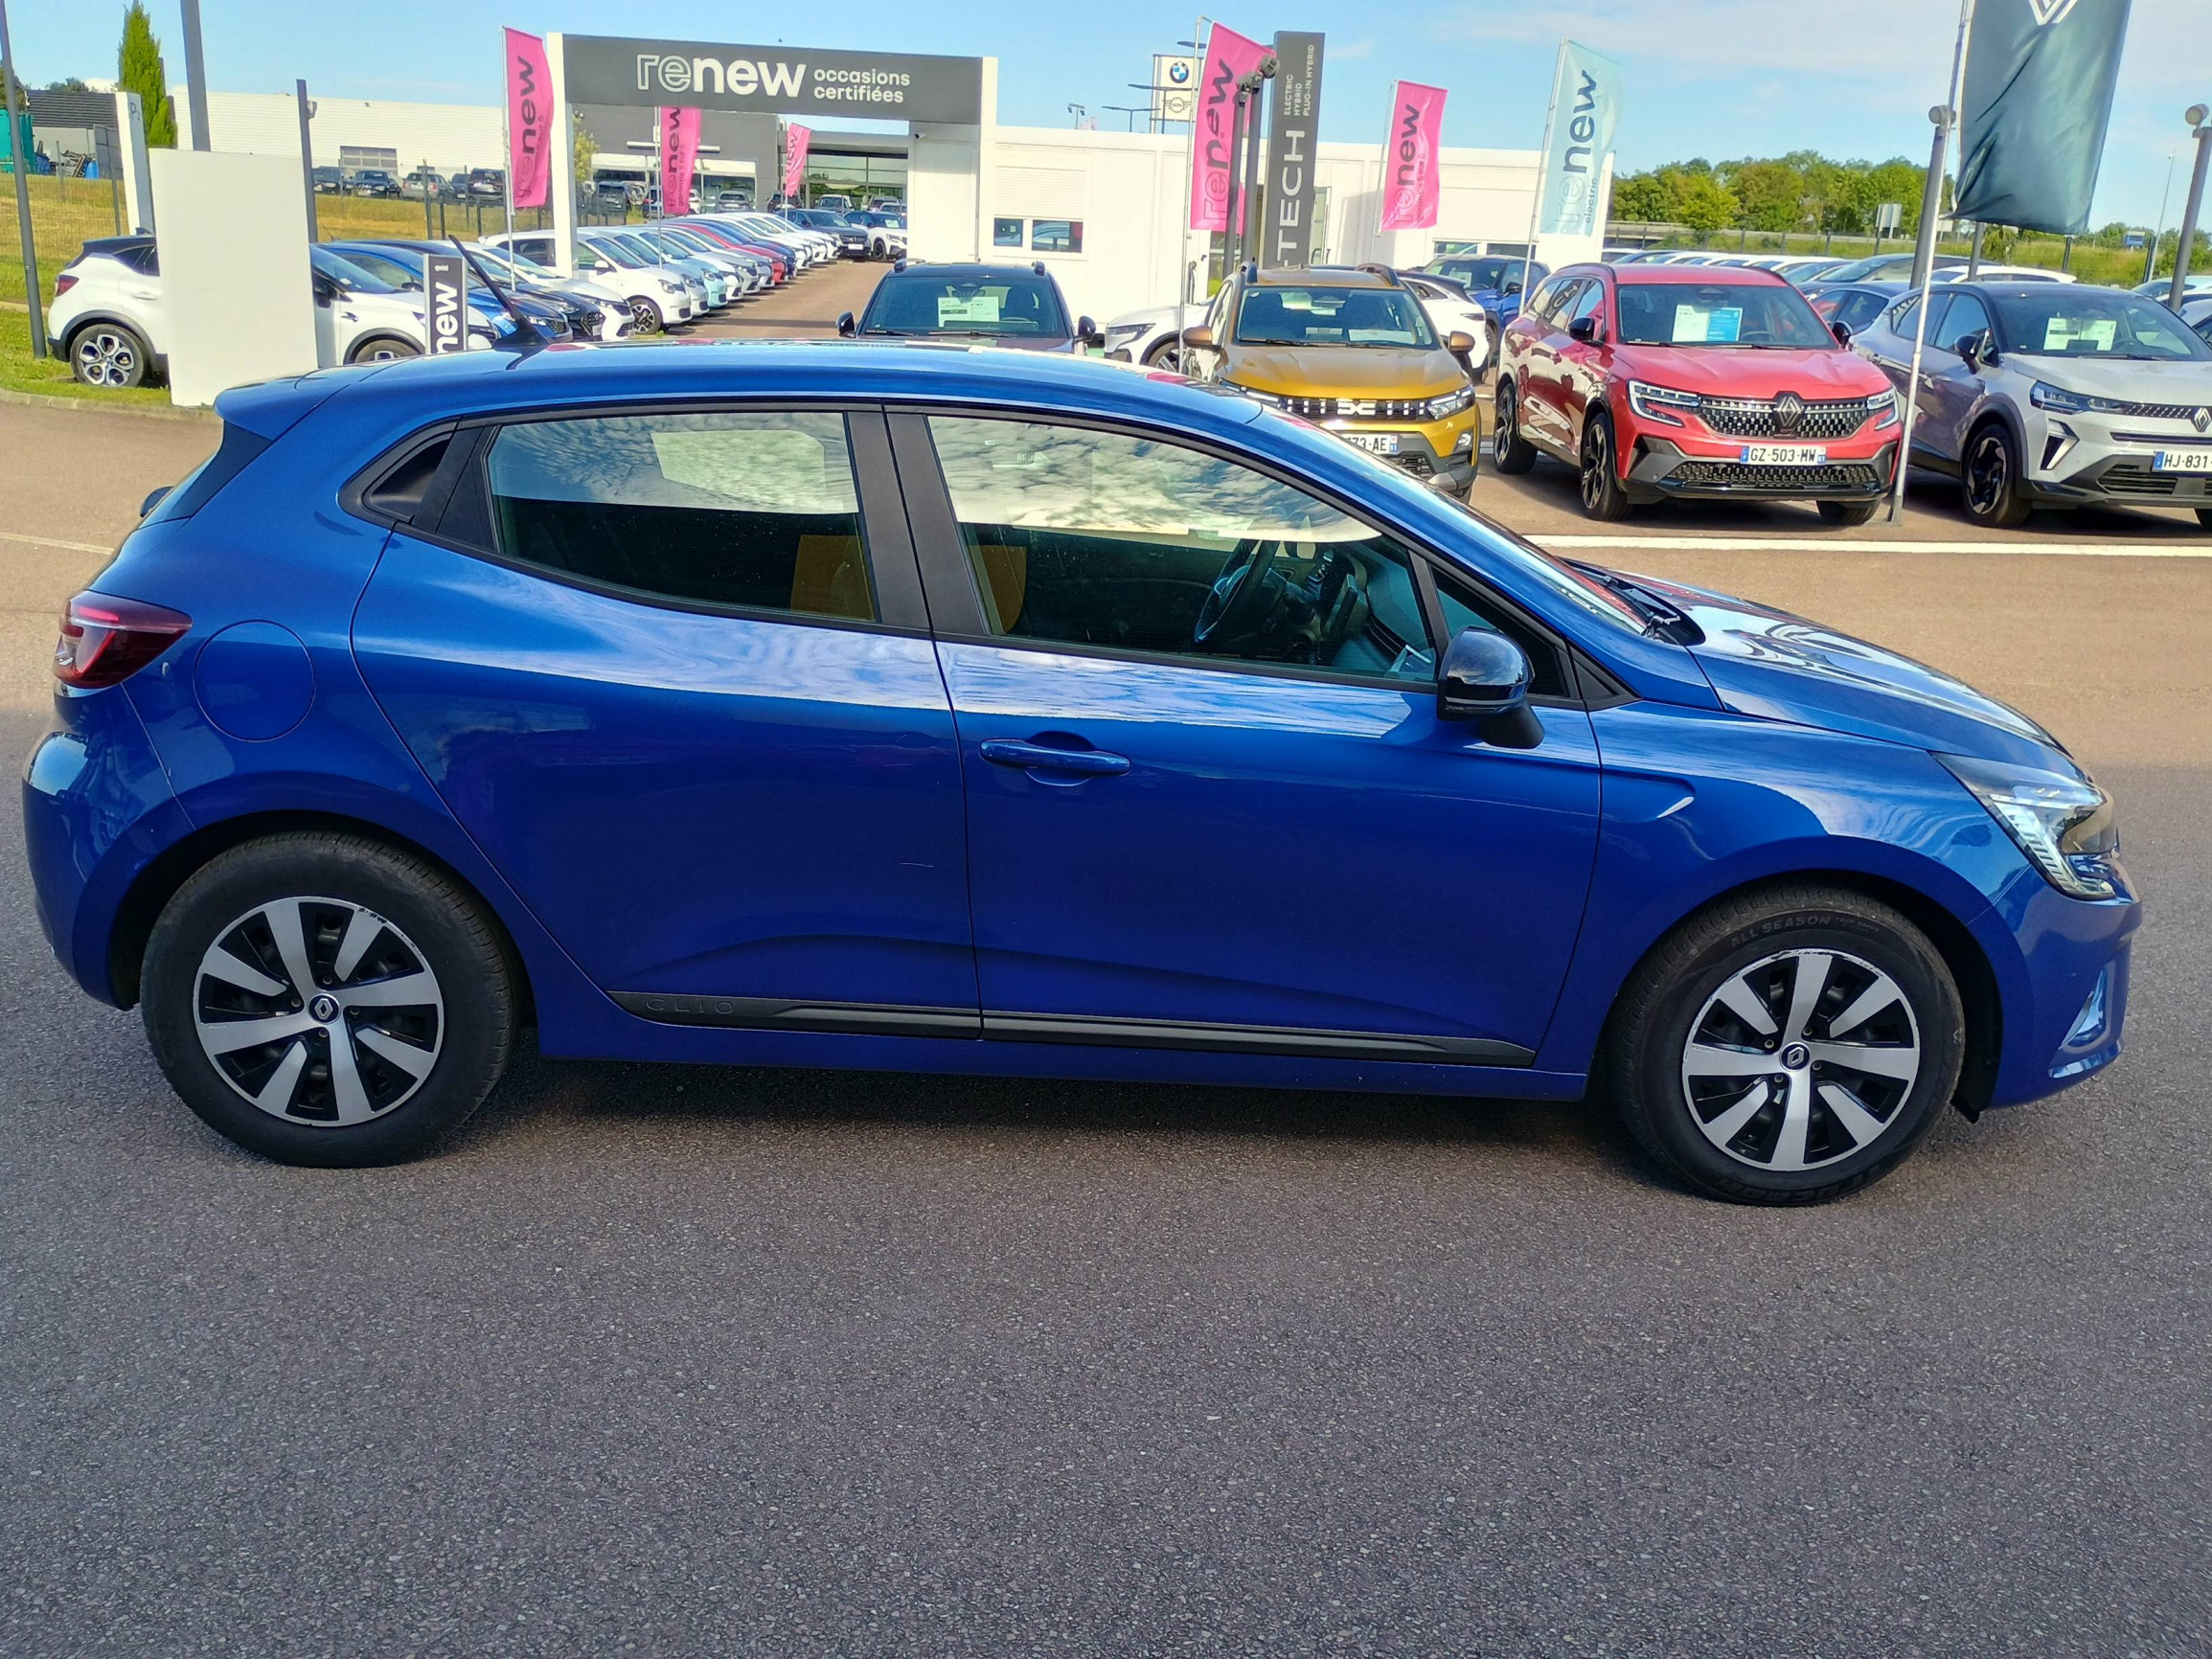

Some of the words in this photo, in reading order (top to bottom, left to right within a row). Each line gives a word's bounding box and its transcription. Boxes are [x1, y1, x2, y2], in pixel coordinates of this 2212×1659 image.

[636, 54, 807, 98] renew
[813, 68, 911, 86] occasions
[1305, 44, 1315, 79] HYBRID
[813, 84, 904, 103] certifiées
[1283, 74, 1294, 116] ELECTRIC
[1293, 82, 1303, 117] HYBRID
[1303, 80, 1313, 117] PLUG-IN
[517, 56, 536, 198] renew
[1202, 57, 1235, 221] renew
[1555, 69, 1597, 222] renew
[1395, 103, 1421, 222] renew
[1585, 177, 1597, 224] electric
[1750, 447, 1816, 463] GZ-503-MW
[1731, 927, 1759, 947] ALL
[1762, 915, 1832, 935] SEASON
[646, 998, 735, 1014] CLIO
